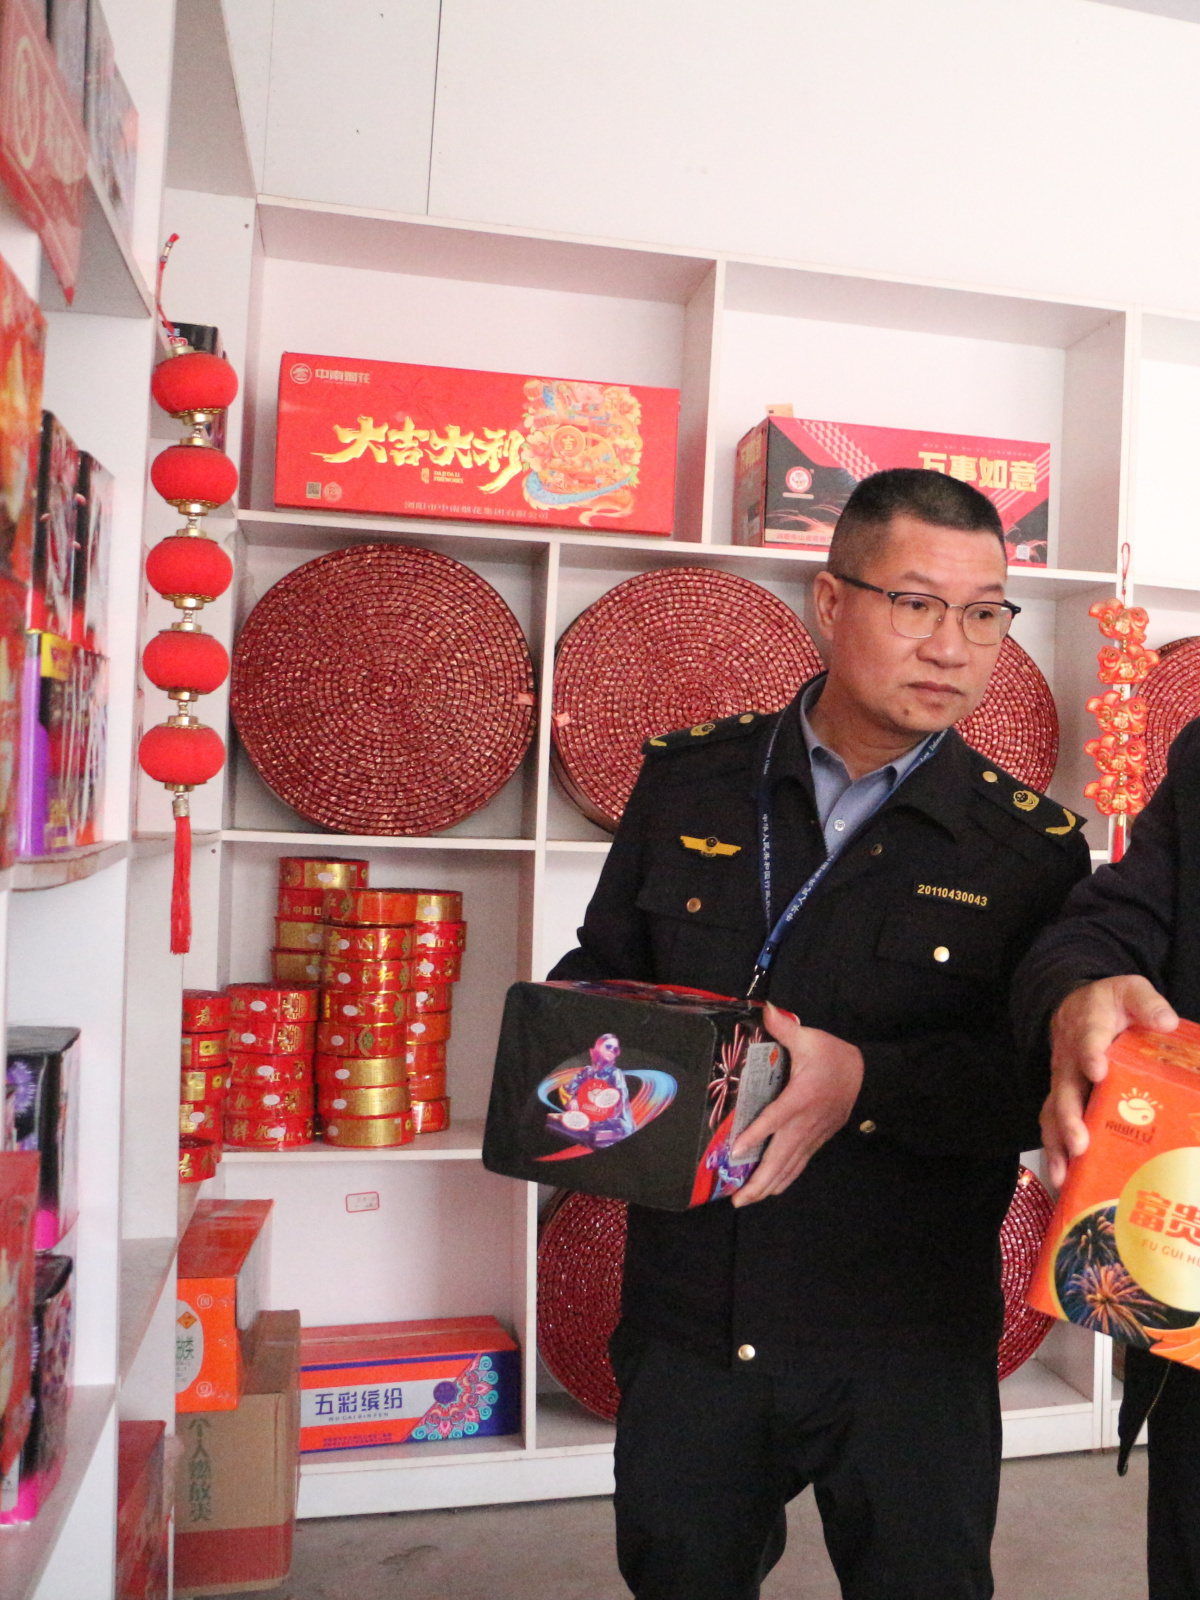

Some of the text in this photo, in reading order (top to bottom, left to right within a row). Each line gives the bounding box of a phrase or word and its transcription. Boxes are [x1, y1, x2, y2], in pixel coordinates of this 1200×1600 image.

[310, 413, 525, 494] 大吉大利
[918, 451, 1037, 492] 万事如意
[917, 884, 988, 907] 20110430043
[1142, 1238, 1158, 1251] FU
[1161, 1245, 1184, 1261] GUI
[315, 1387, 403, 1416] 五彩缤纷
